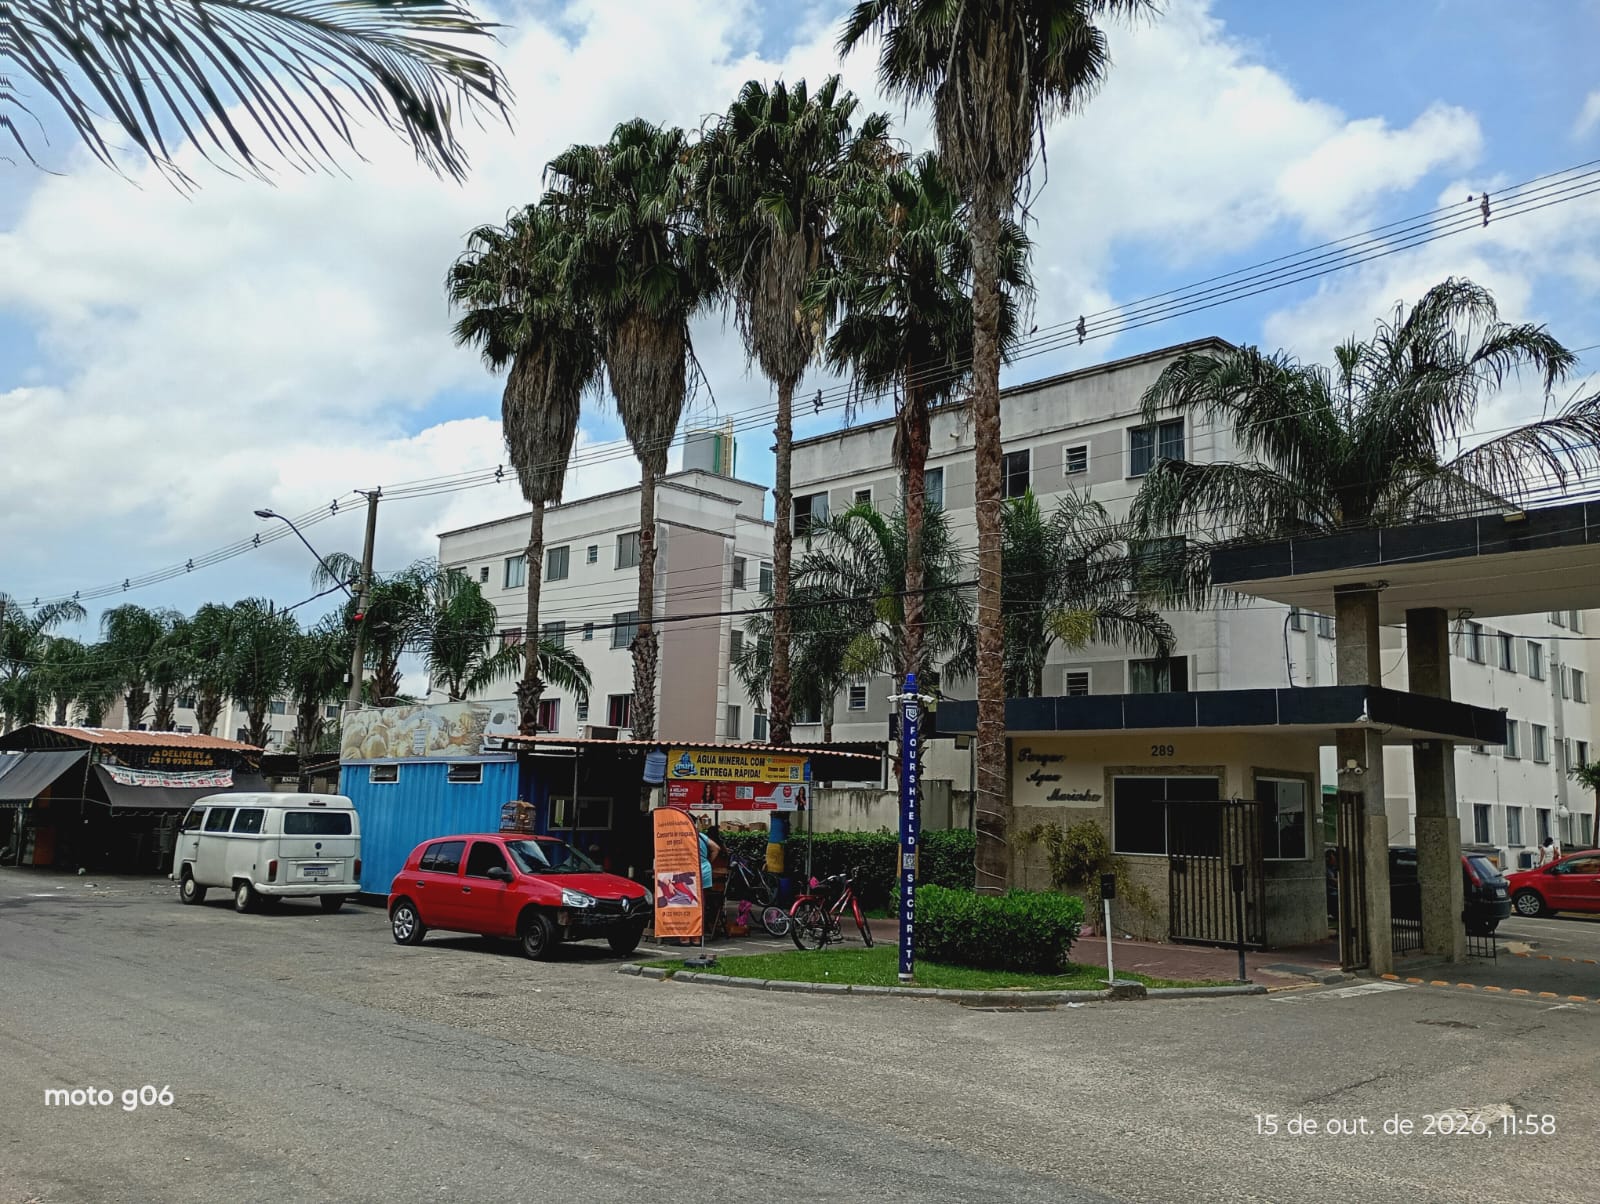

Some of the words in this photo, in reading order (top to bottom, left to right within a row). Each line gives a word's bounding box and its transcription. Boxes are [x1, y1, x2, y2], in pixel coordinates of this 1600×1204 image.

[161, 750, 204, 759] DELIVERY
[1152, 744, 1174, 756] 289
[718, 755, 748, 766] MINERAL
[750, 757, 765, 767] COM
[700, 767, 733, 777] ENTREGA
[735, 766, 761, 778] RÁPIDA!
[908, 727, 917, 844] FOURSHIELD
[906, 874, 914, 971] SECURITY
